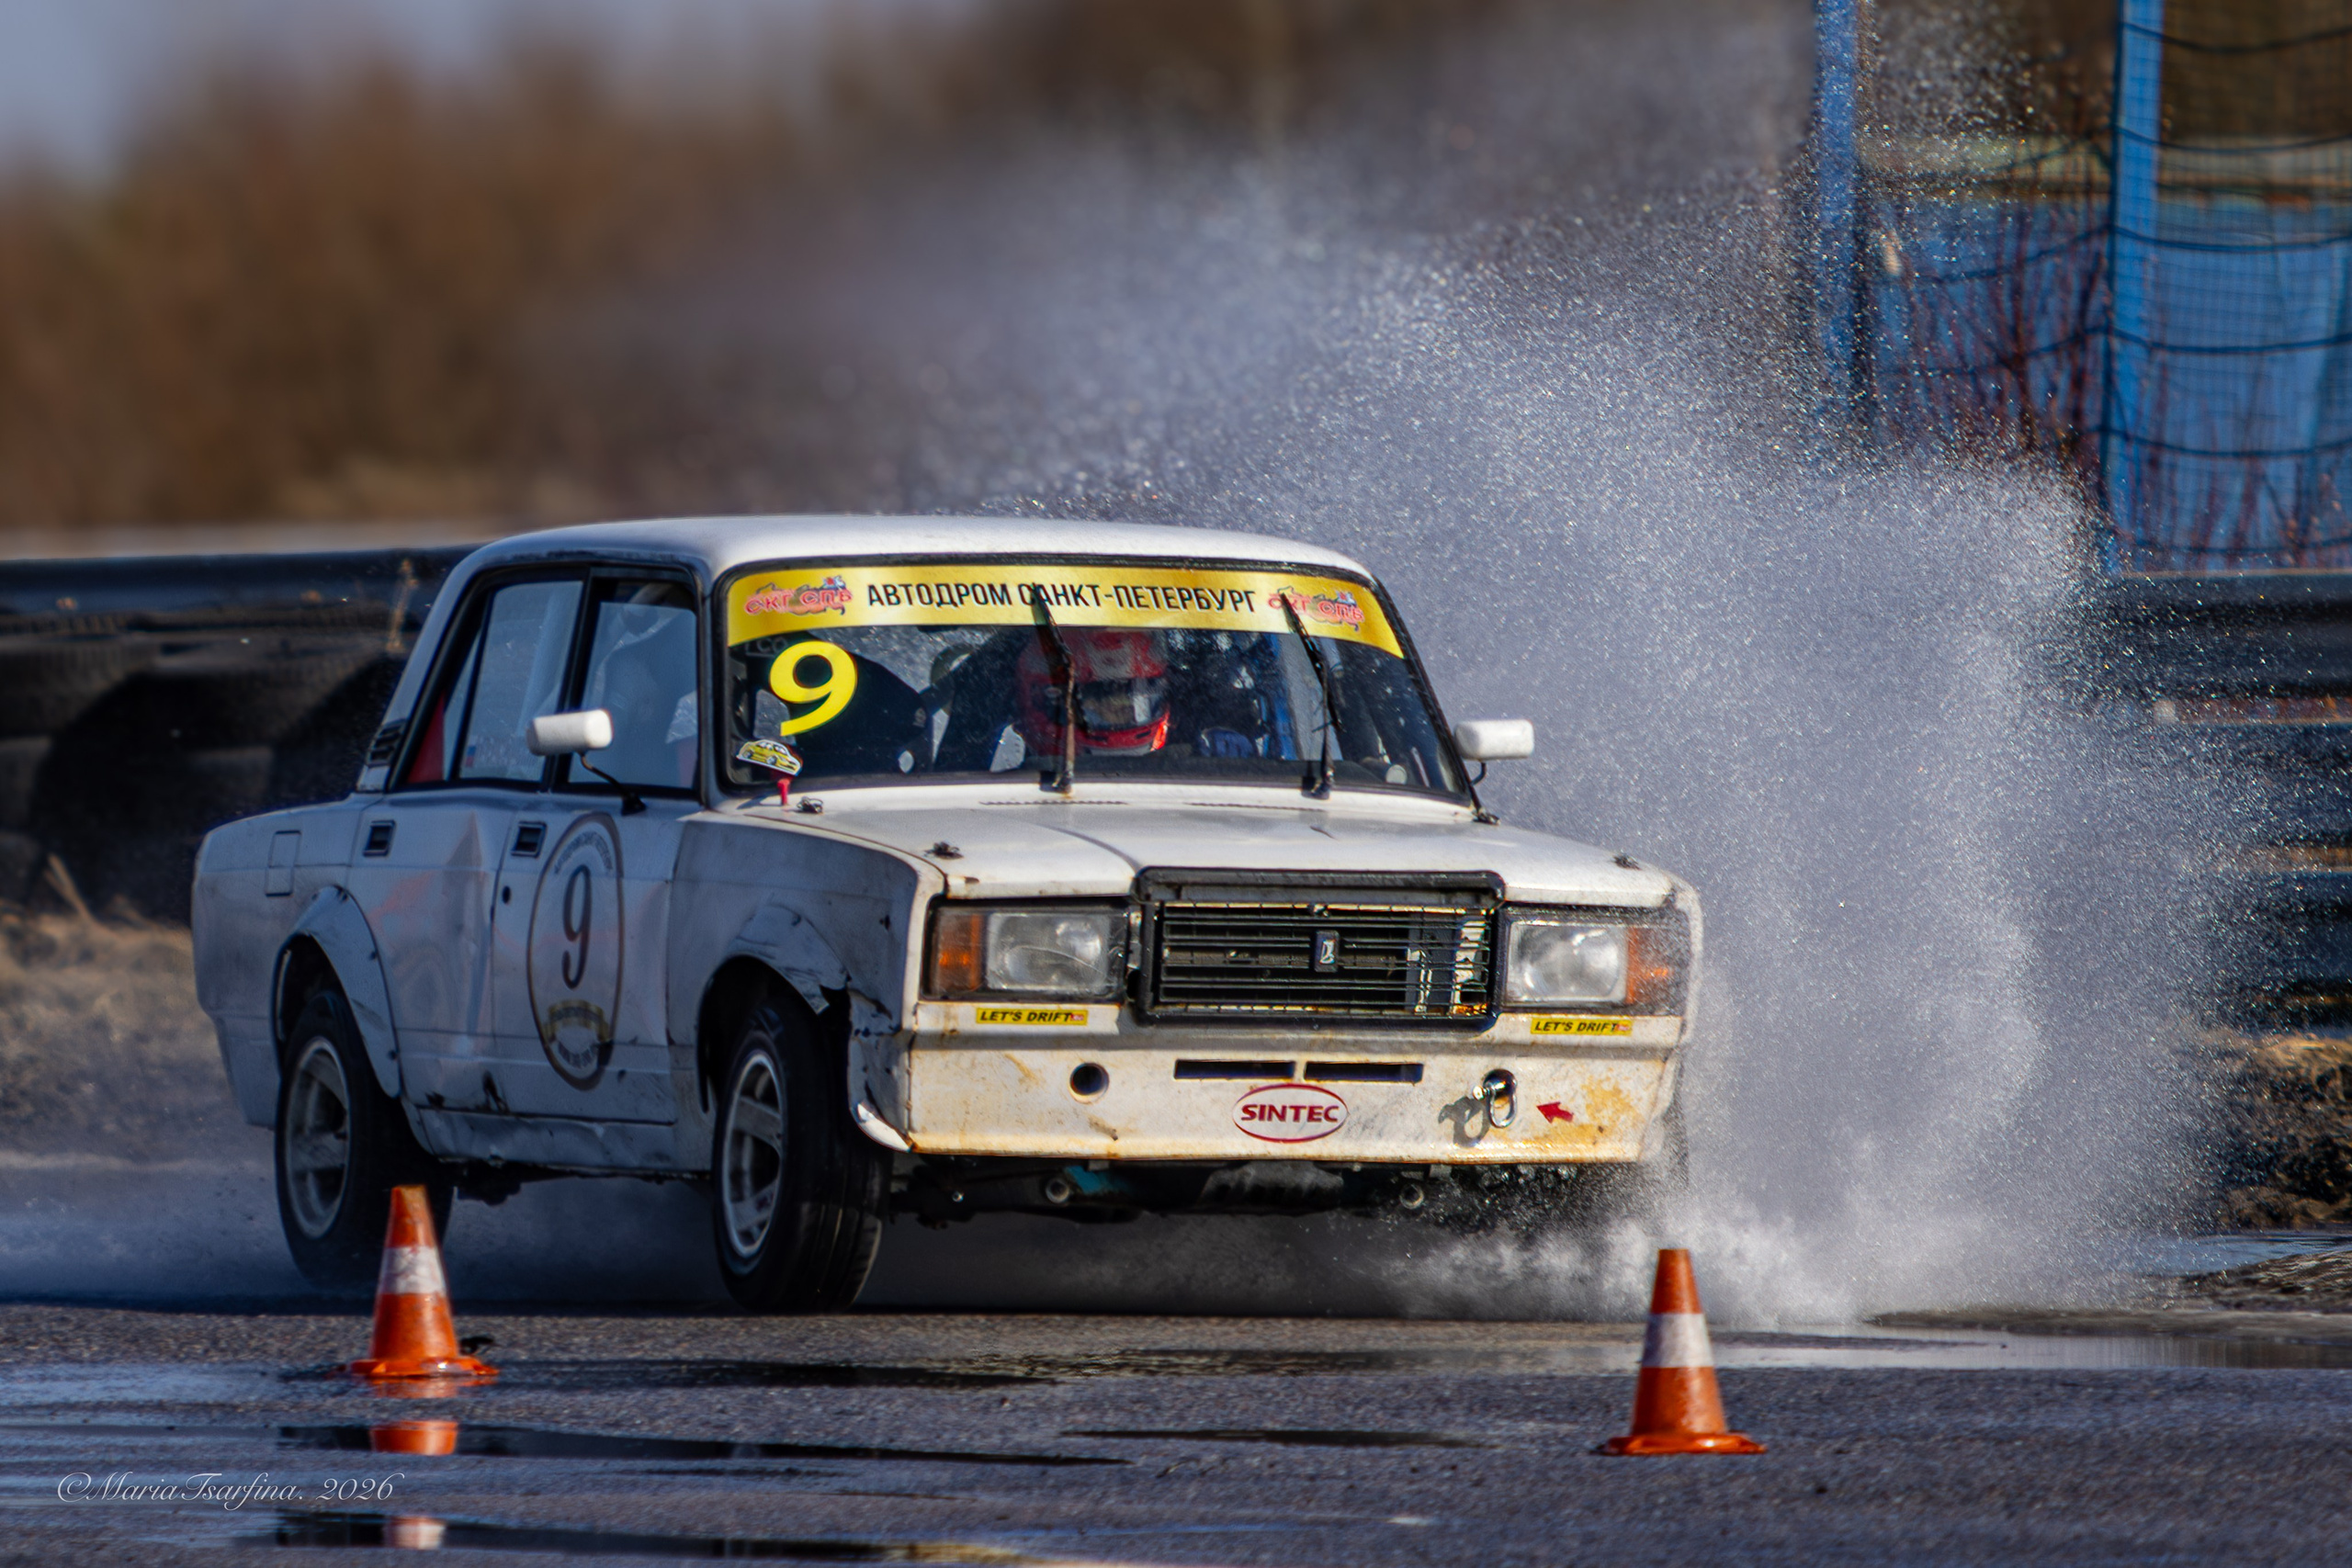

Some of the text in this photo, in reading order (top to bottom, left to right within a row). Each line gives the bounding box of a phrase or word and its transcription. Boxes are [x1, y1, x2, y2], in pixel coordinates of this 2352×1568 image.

[867, 582, 1256, 613] АВТОДРОМ САНКТ-ПЕТЕРБУРГ
[769, 641, 858, 737] 9
[562, 864, 593, 990] 9
[979, 1010, 1023, 1021] LET'S
[1534, 1021, 1574, 1032] LET'S
[1240, 1103, 1340, 1122] SINTEC
